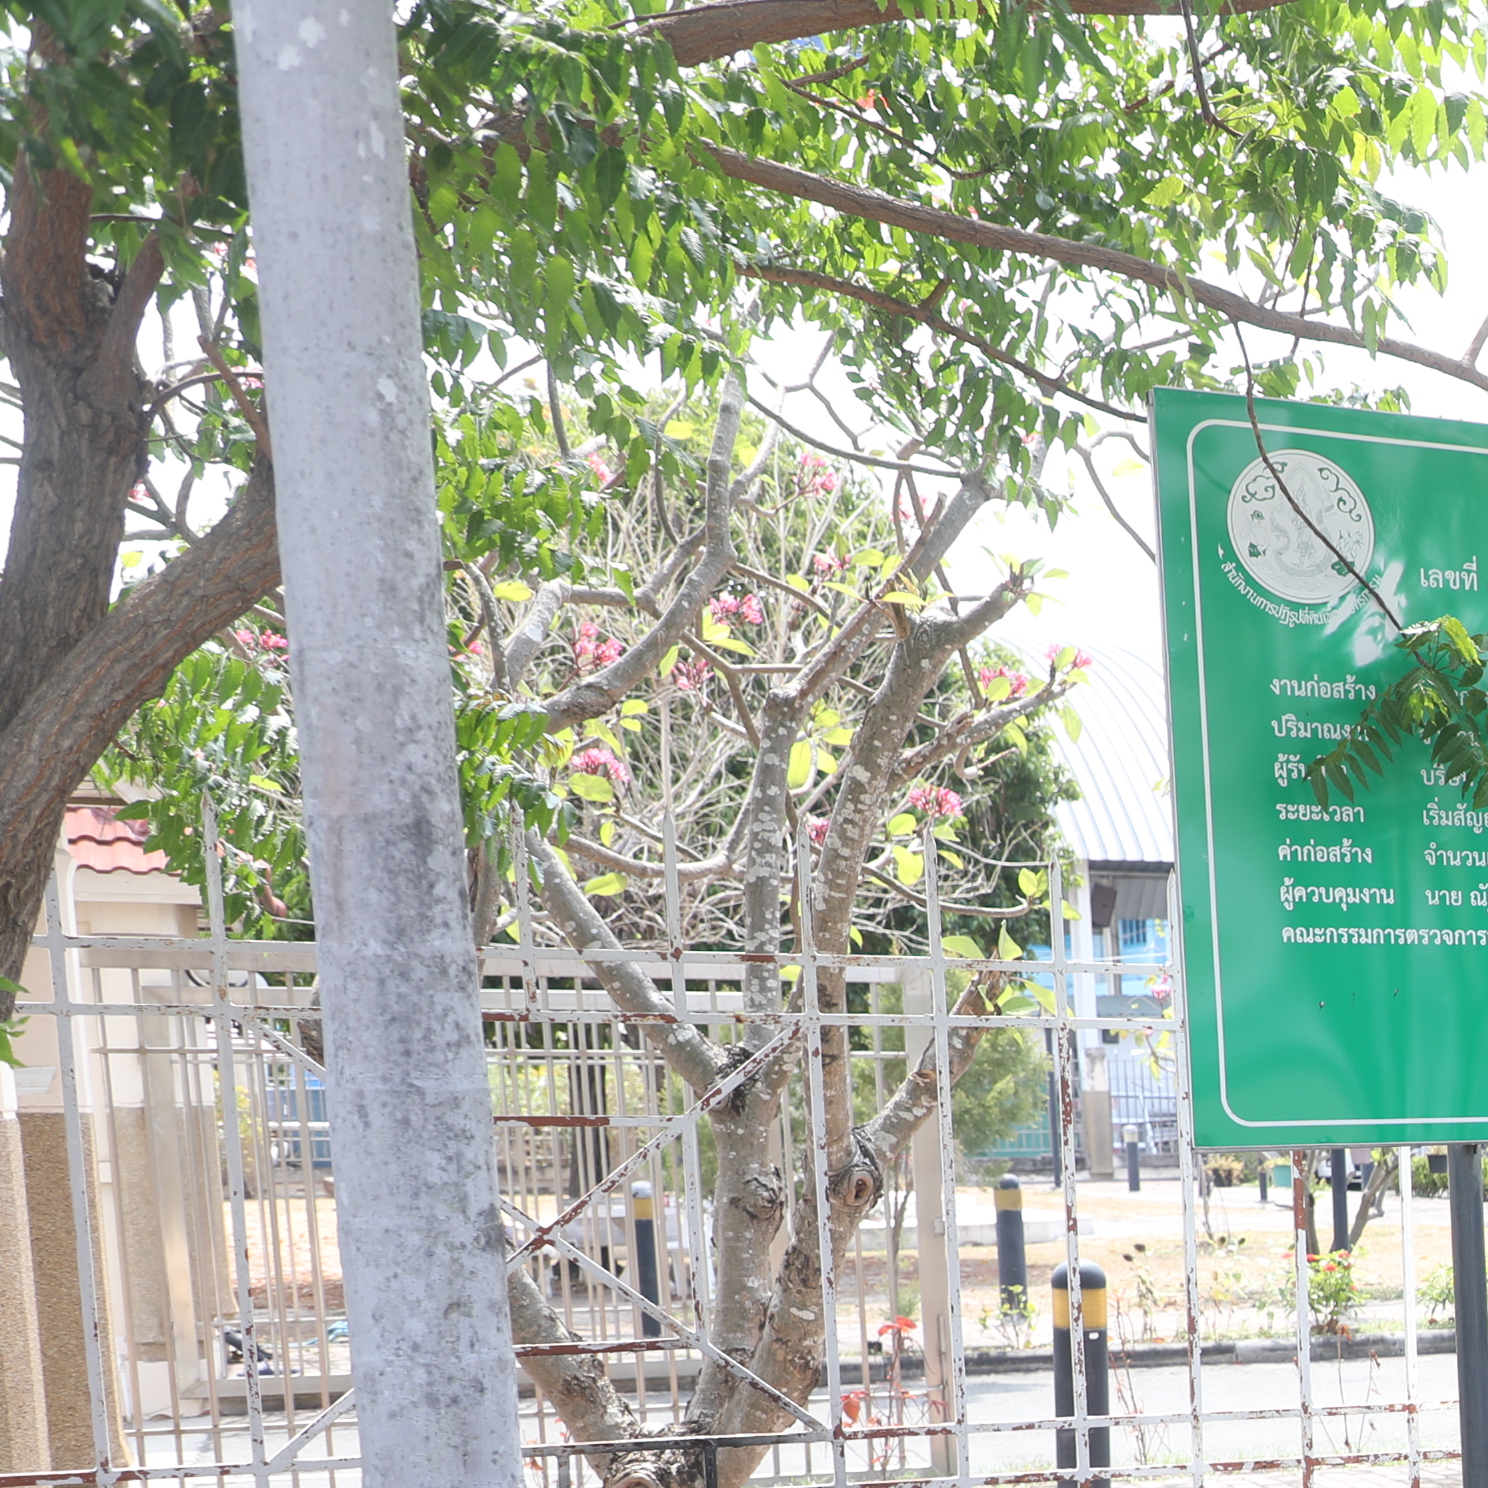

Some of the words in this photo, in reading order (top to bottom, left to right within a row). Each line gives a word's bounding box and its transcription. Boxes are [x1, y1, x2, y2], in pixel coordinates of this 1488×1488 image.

[1420, 556, 1478, 592] เลขที่
[1269, 673, 1376, 701] งานก่อสร้าง
[1275, 800, 1365, 823] ระยะเวลา
[1277, 838, 1373, 864] ค่าก่อสร้าง
[1279, 877, 1395, 911] ผู้ควบคุมงาน
[1425, 888, 1463, 907] นาย
